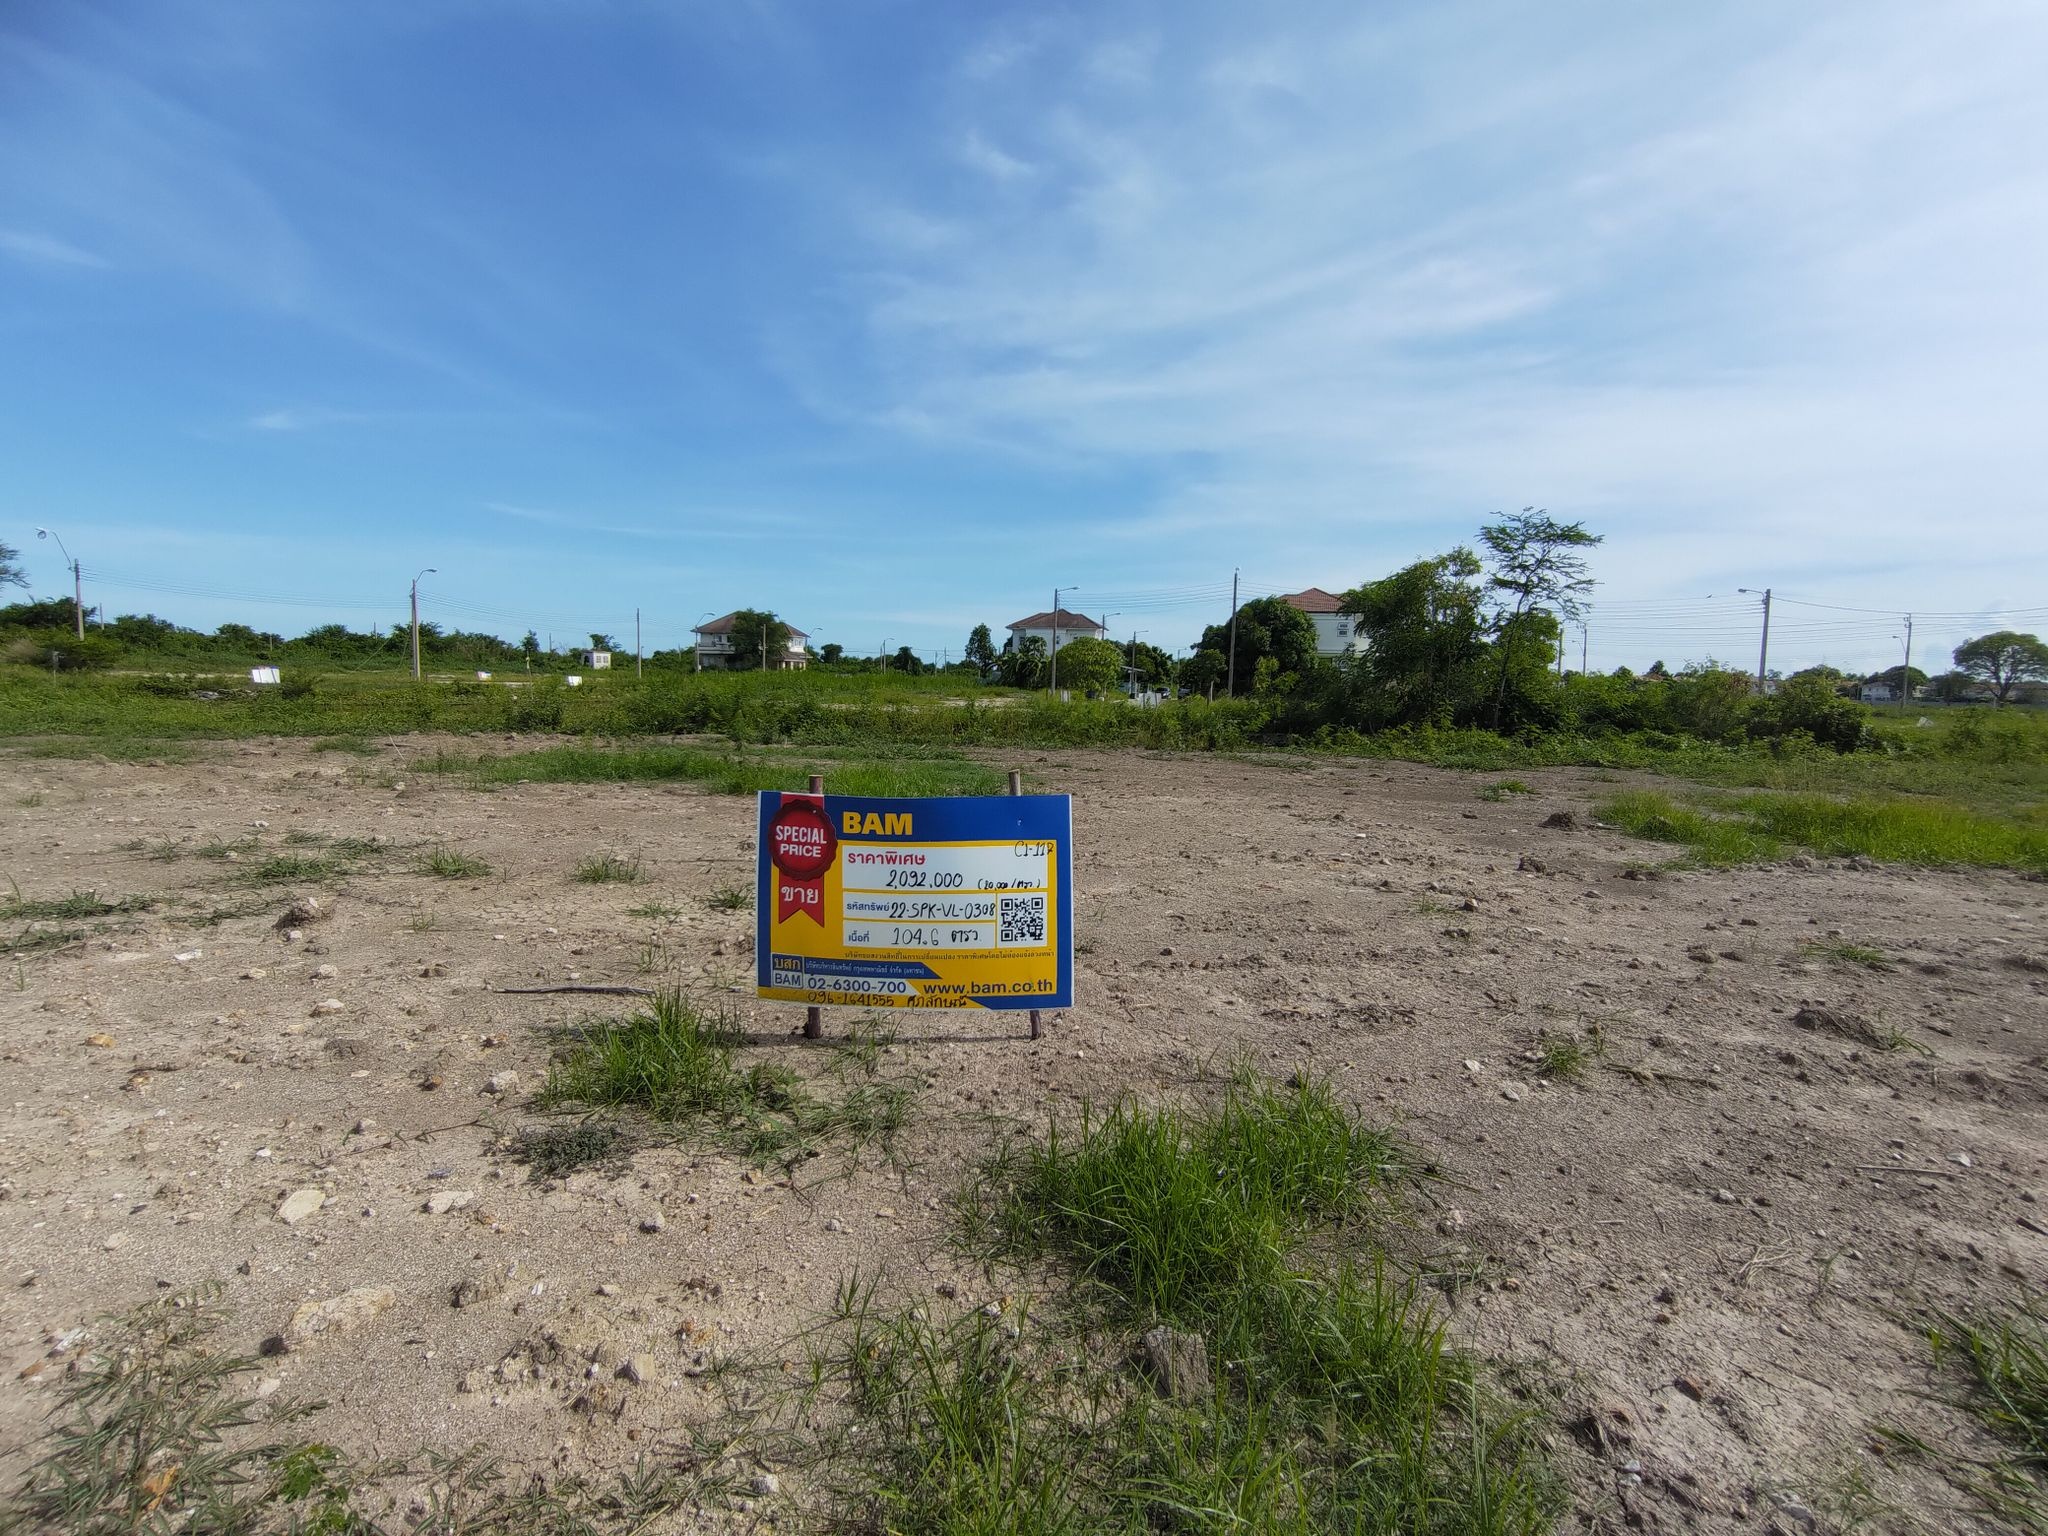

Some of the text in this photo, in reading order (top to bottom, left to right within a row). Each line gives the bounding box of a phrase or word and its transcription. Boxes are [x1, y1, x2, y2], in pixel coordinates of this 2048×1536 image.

[842, 811, 913, 836] BAM
[775, 825, 827, 845] SPECIAL
[780, 843, 822, 858] PRICE
[847, 850, 926, 866] ราคาพิเศษ
[781, 885, 819, 905] ขาย
[846, 901, 890, 913] รหัสทรัพย์
[848, 930, 870, 943] เนื้อที่
[773, 957, 801, 970] บสก
[774, 972, 801, 986] BAM
[807, 977, 907, 994] 02-6300-700
[923, 979, 1053, 994] www.bam.co.th
